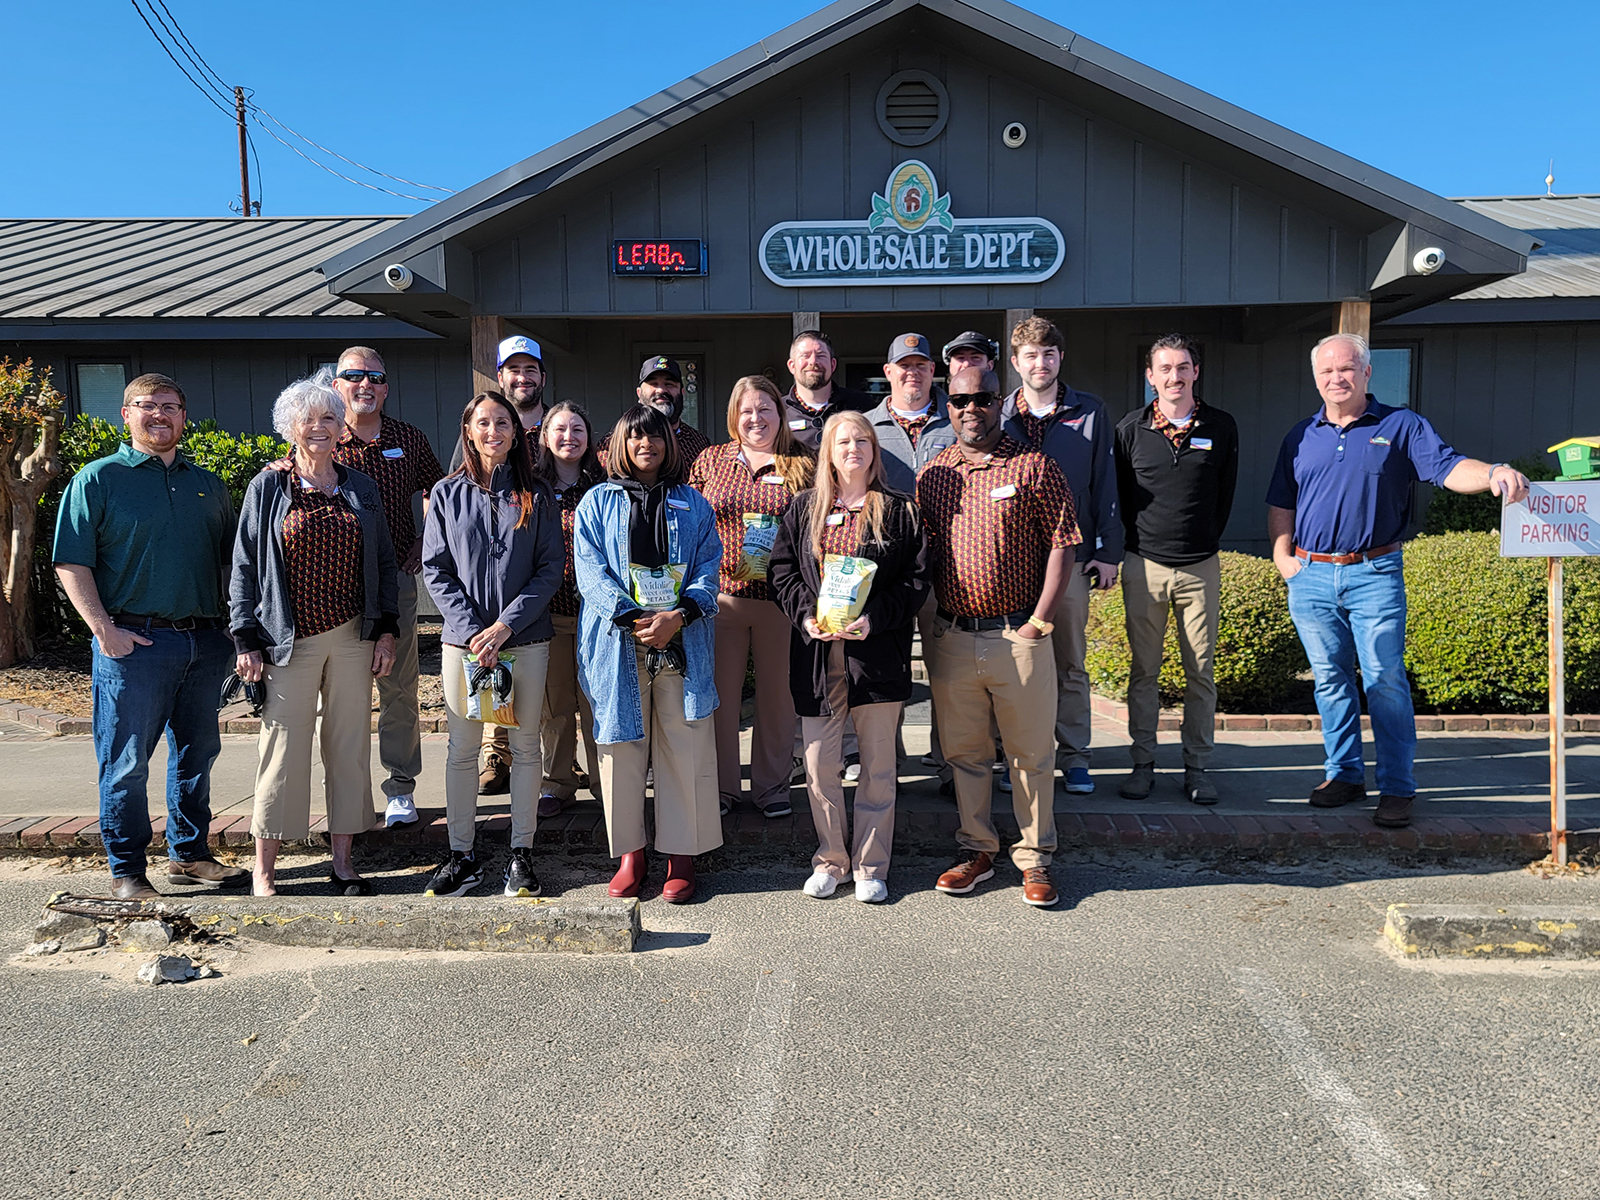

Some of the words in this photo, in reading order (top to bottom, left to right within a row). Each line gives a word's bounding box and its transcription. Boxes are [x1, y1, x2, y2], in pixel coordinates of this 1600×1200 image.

[783, 233, 951, 272] WHOLESALE
[963, 230, 1042, 269] DEPT.
[1527, 494, 1589, 515] VISITOR
[749, 536, 771, 547] PETALS
[1521, 522, 1589, 543] PARKING
